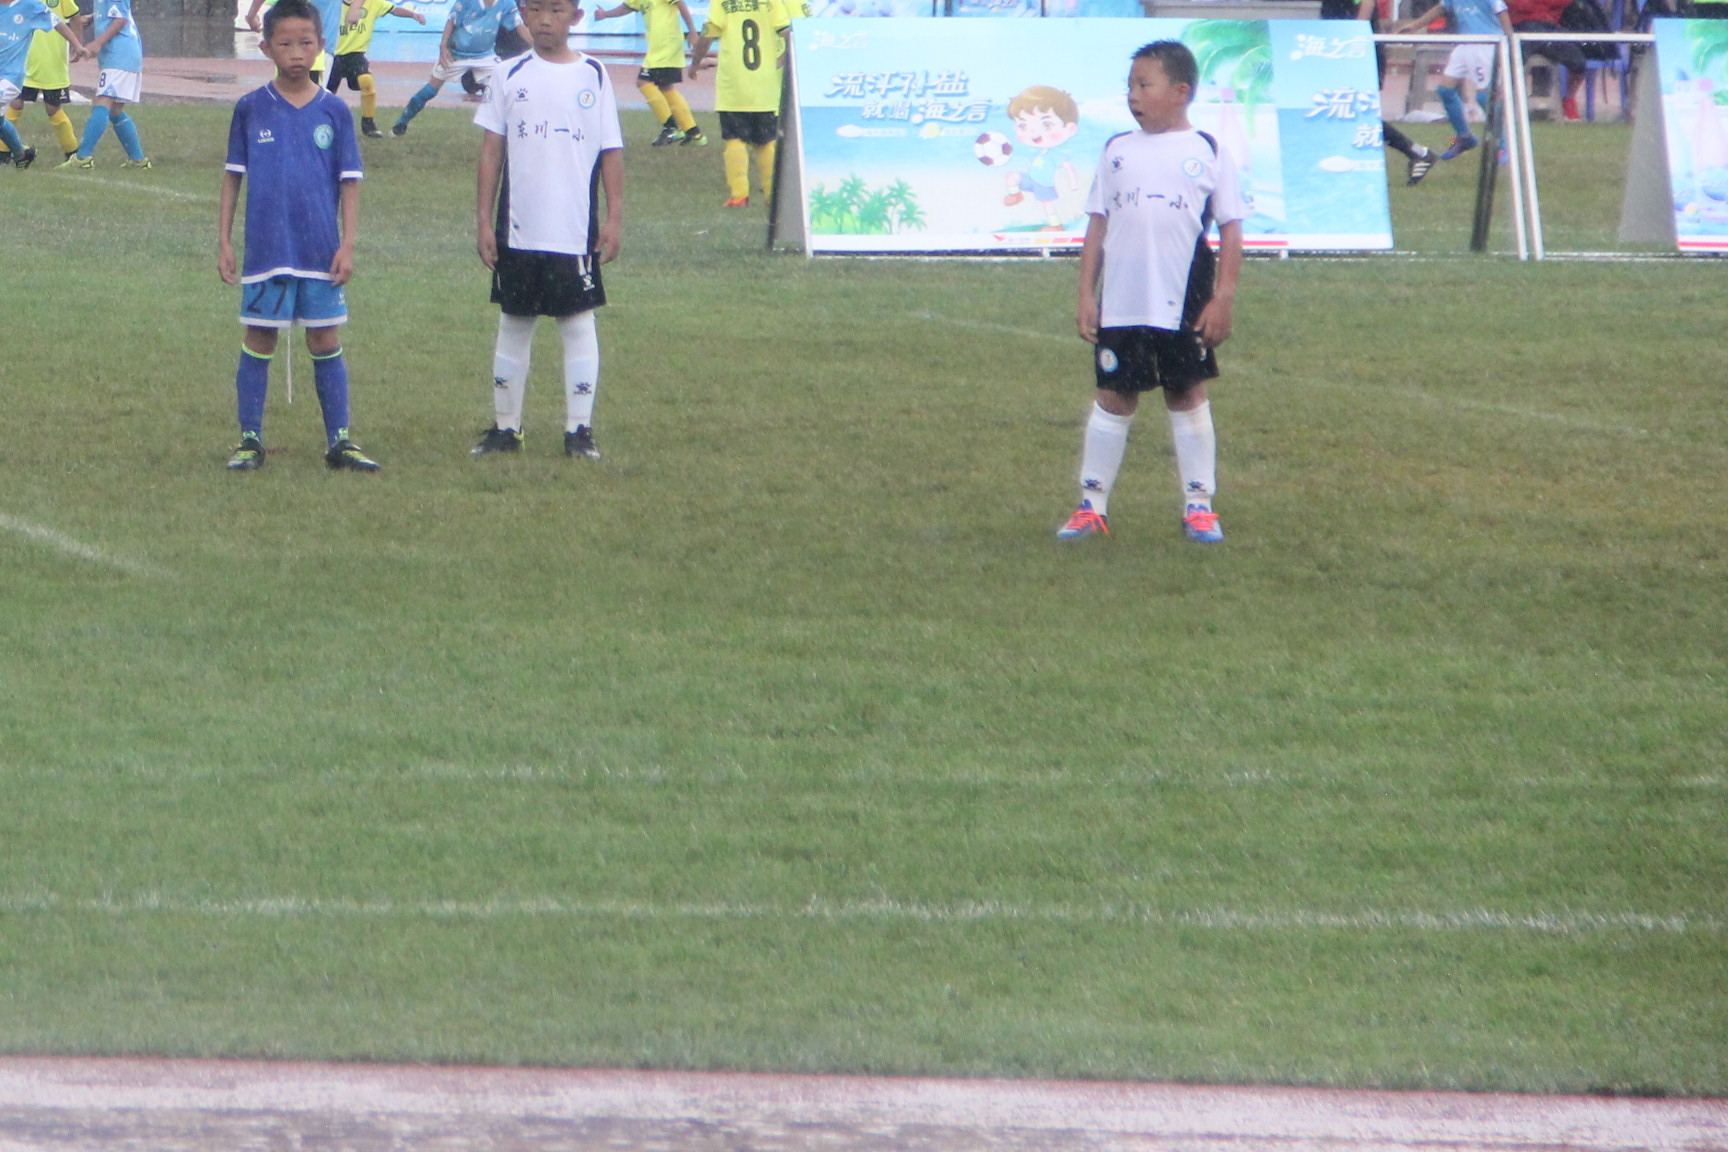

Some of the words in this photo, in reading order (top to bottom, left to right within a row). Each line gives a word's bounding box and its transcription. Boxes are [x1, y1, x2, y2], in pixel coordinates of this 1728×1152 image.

[742, 18, 762, 72] 8
[1289, 32, 1372, 61] 海之言
[824, 68, 970, 98] 流汗补盐
[860, 97, 993, 125] 就喝海之言
[246, 277, 288, 316] 27
